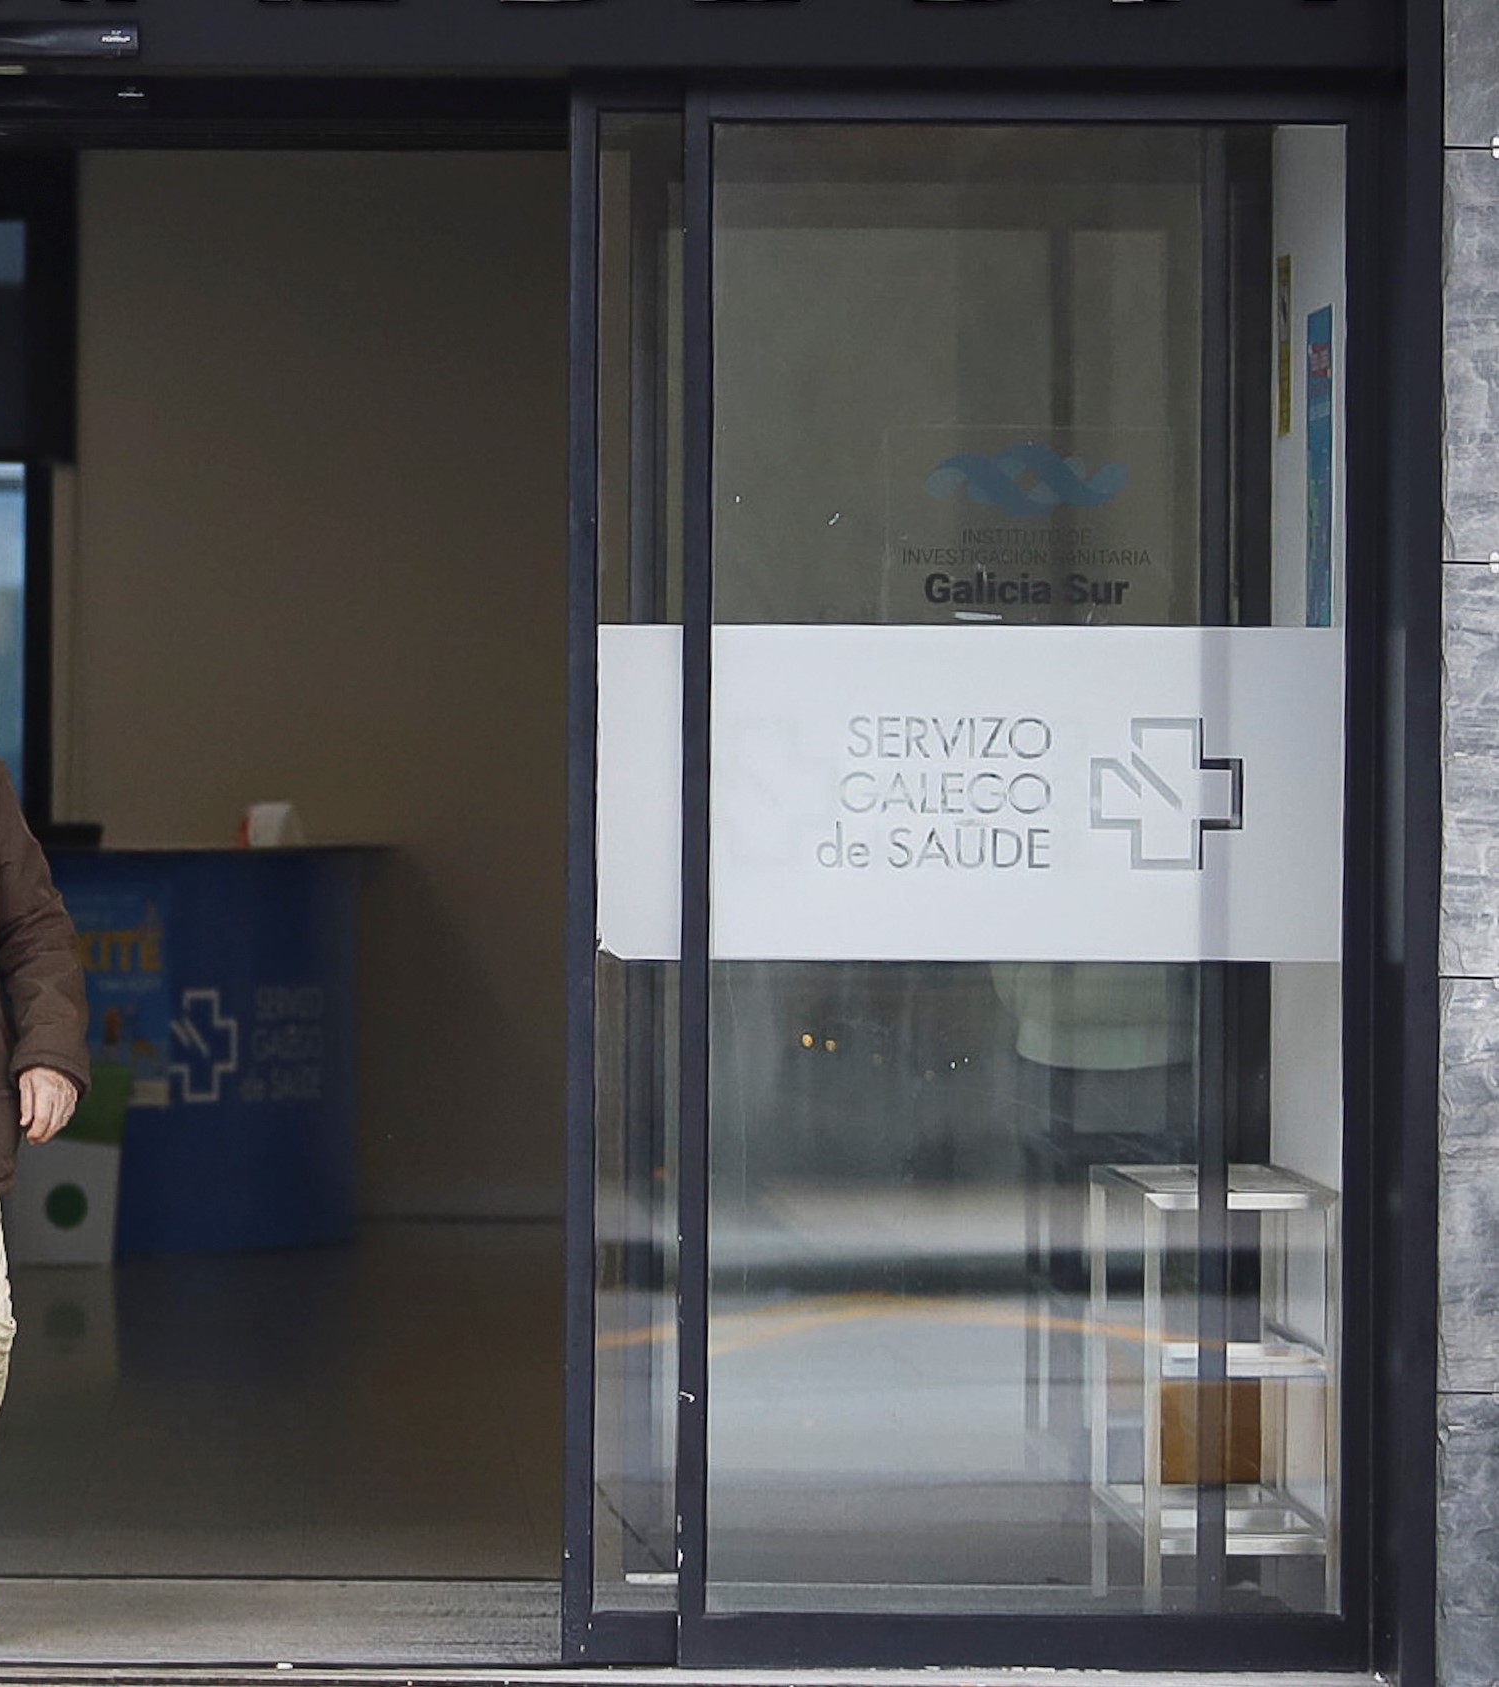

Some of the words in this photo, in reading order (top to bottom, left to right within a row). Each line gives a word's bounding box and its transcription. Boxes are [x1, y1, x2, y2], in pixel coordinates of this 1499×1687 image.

[925, 572, 1051, 605] Galicia
[1061, 572, 1130, 605] Sur
[846, 715, 1052, 760] SERVIZO
[839, 771, 1052, 815] GALEGO
[816, 821, 871, 869] de
